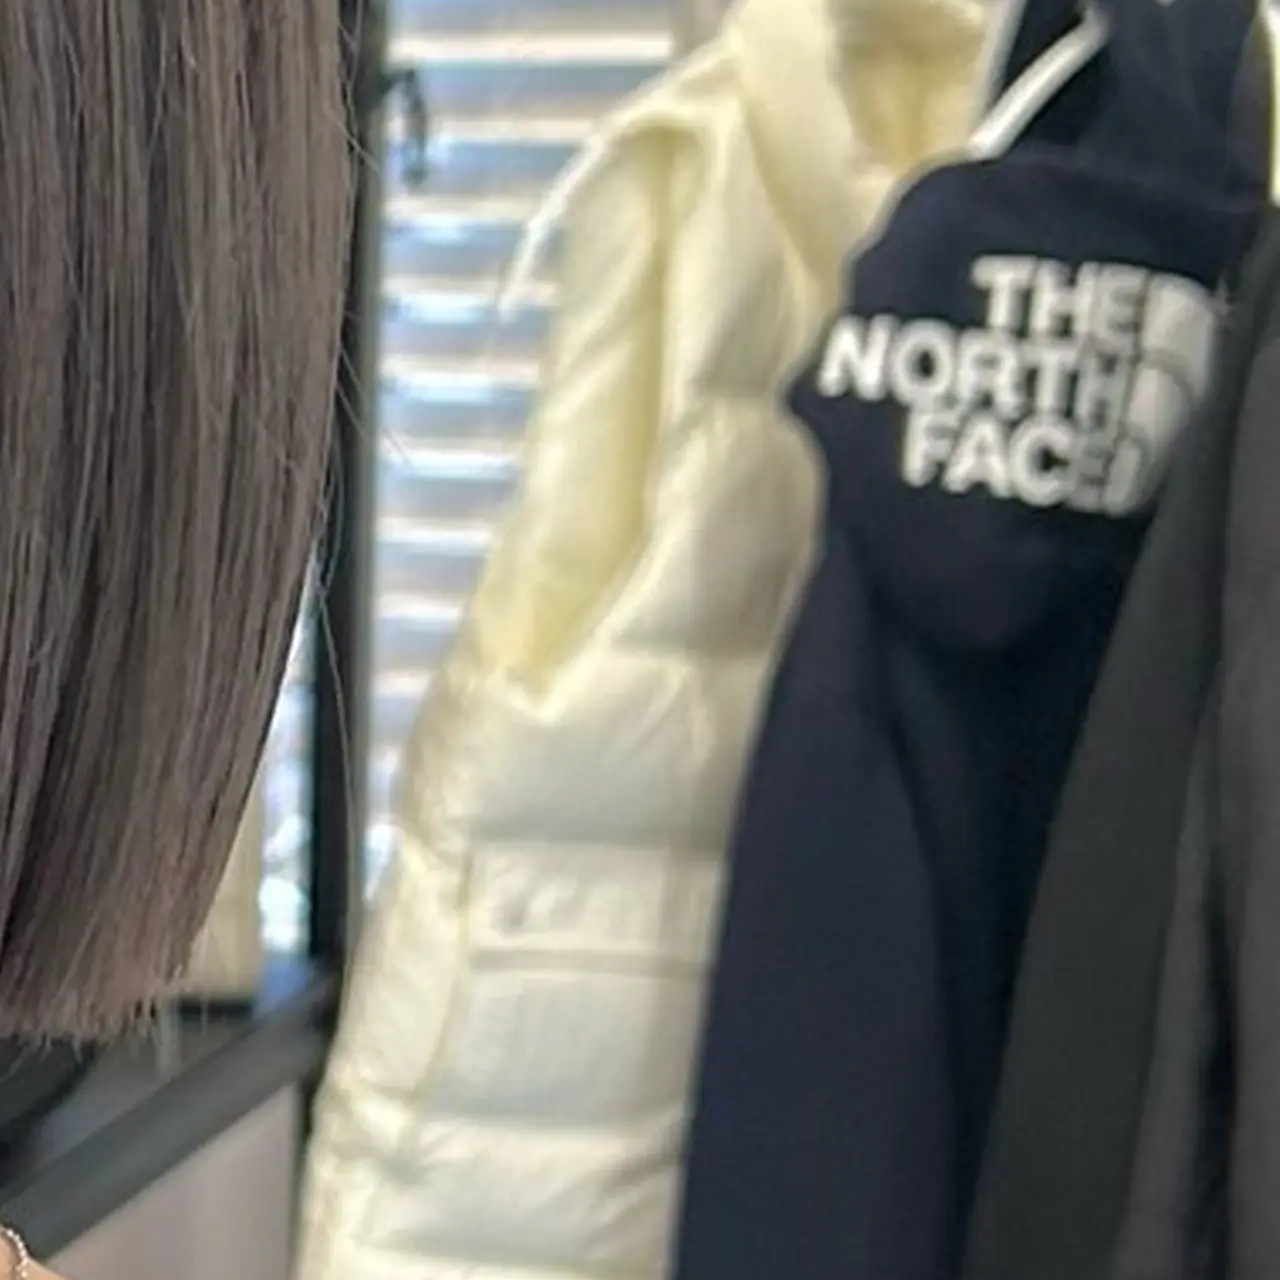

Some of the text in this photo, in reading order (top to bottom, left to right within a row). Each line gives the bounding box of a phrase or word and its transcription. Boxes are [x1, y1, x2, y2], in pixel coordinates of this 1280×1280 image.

[970, 253, 1148, 346] THE
[817, 314, 1132, 434] NORTH
[902, 408, 1118, 514] FACE
